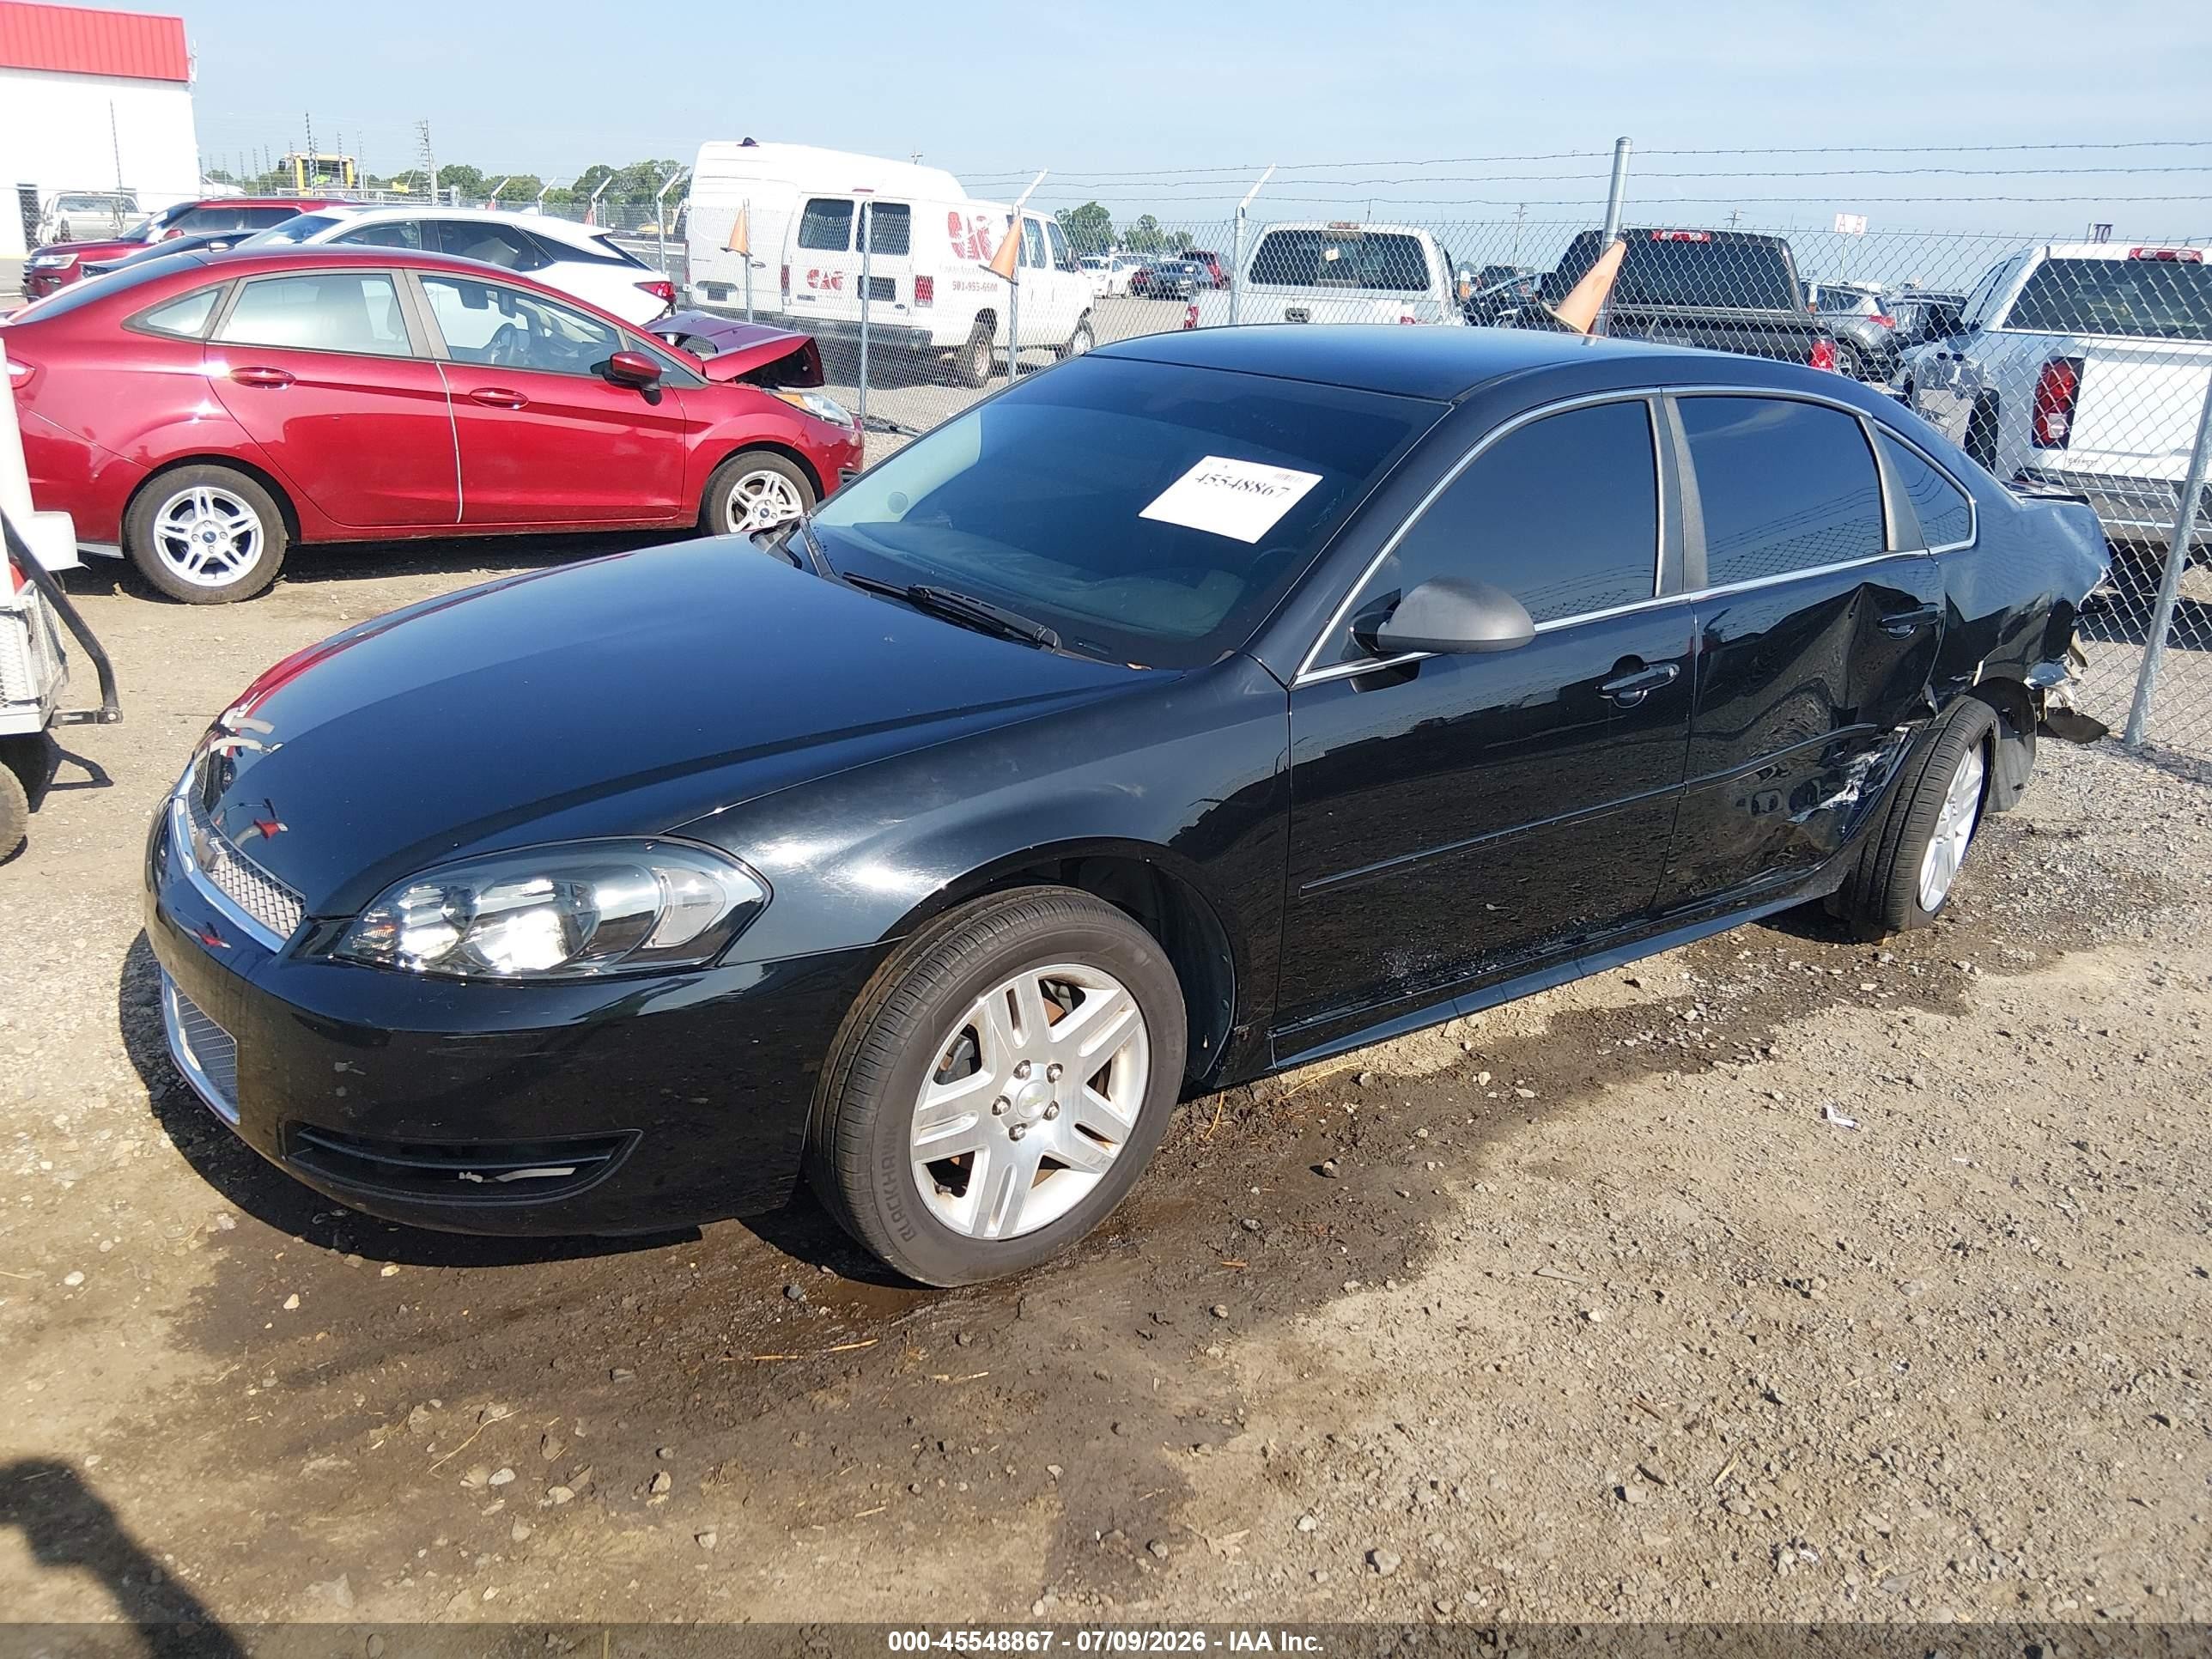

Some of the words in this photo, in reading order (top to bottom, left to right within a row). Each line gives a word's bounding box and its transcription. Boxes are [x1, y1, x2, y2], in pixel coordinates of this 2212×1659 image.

[1837, 214, 1846, 233] A
[2094, 225, 2112, 244] 10
[1194, 471, 1291, 498] 45548867
[881, 1126, 916, 1241] BLACKHAWK
